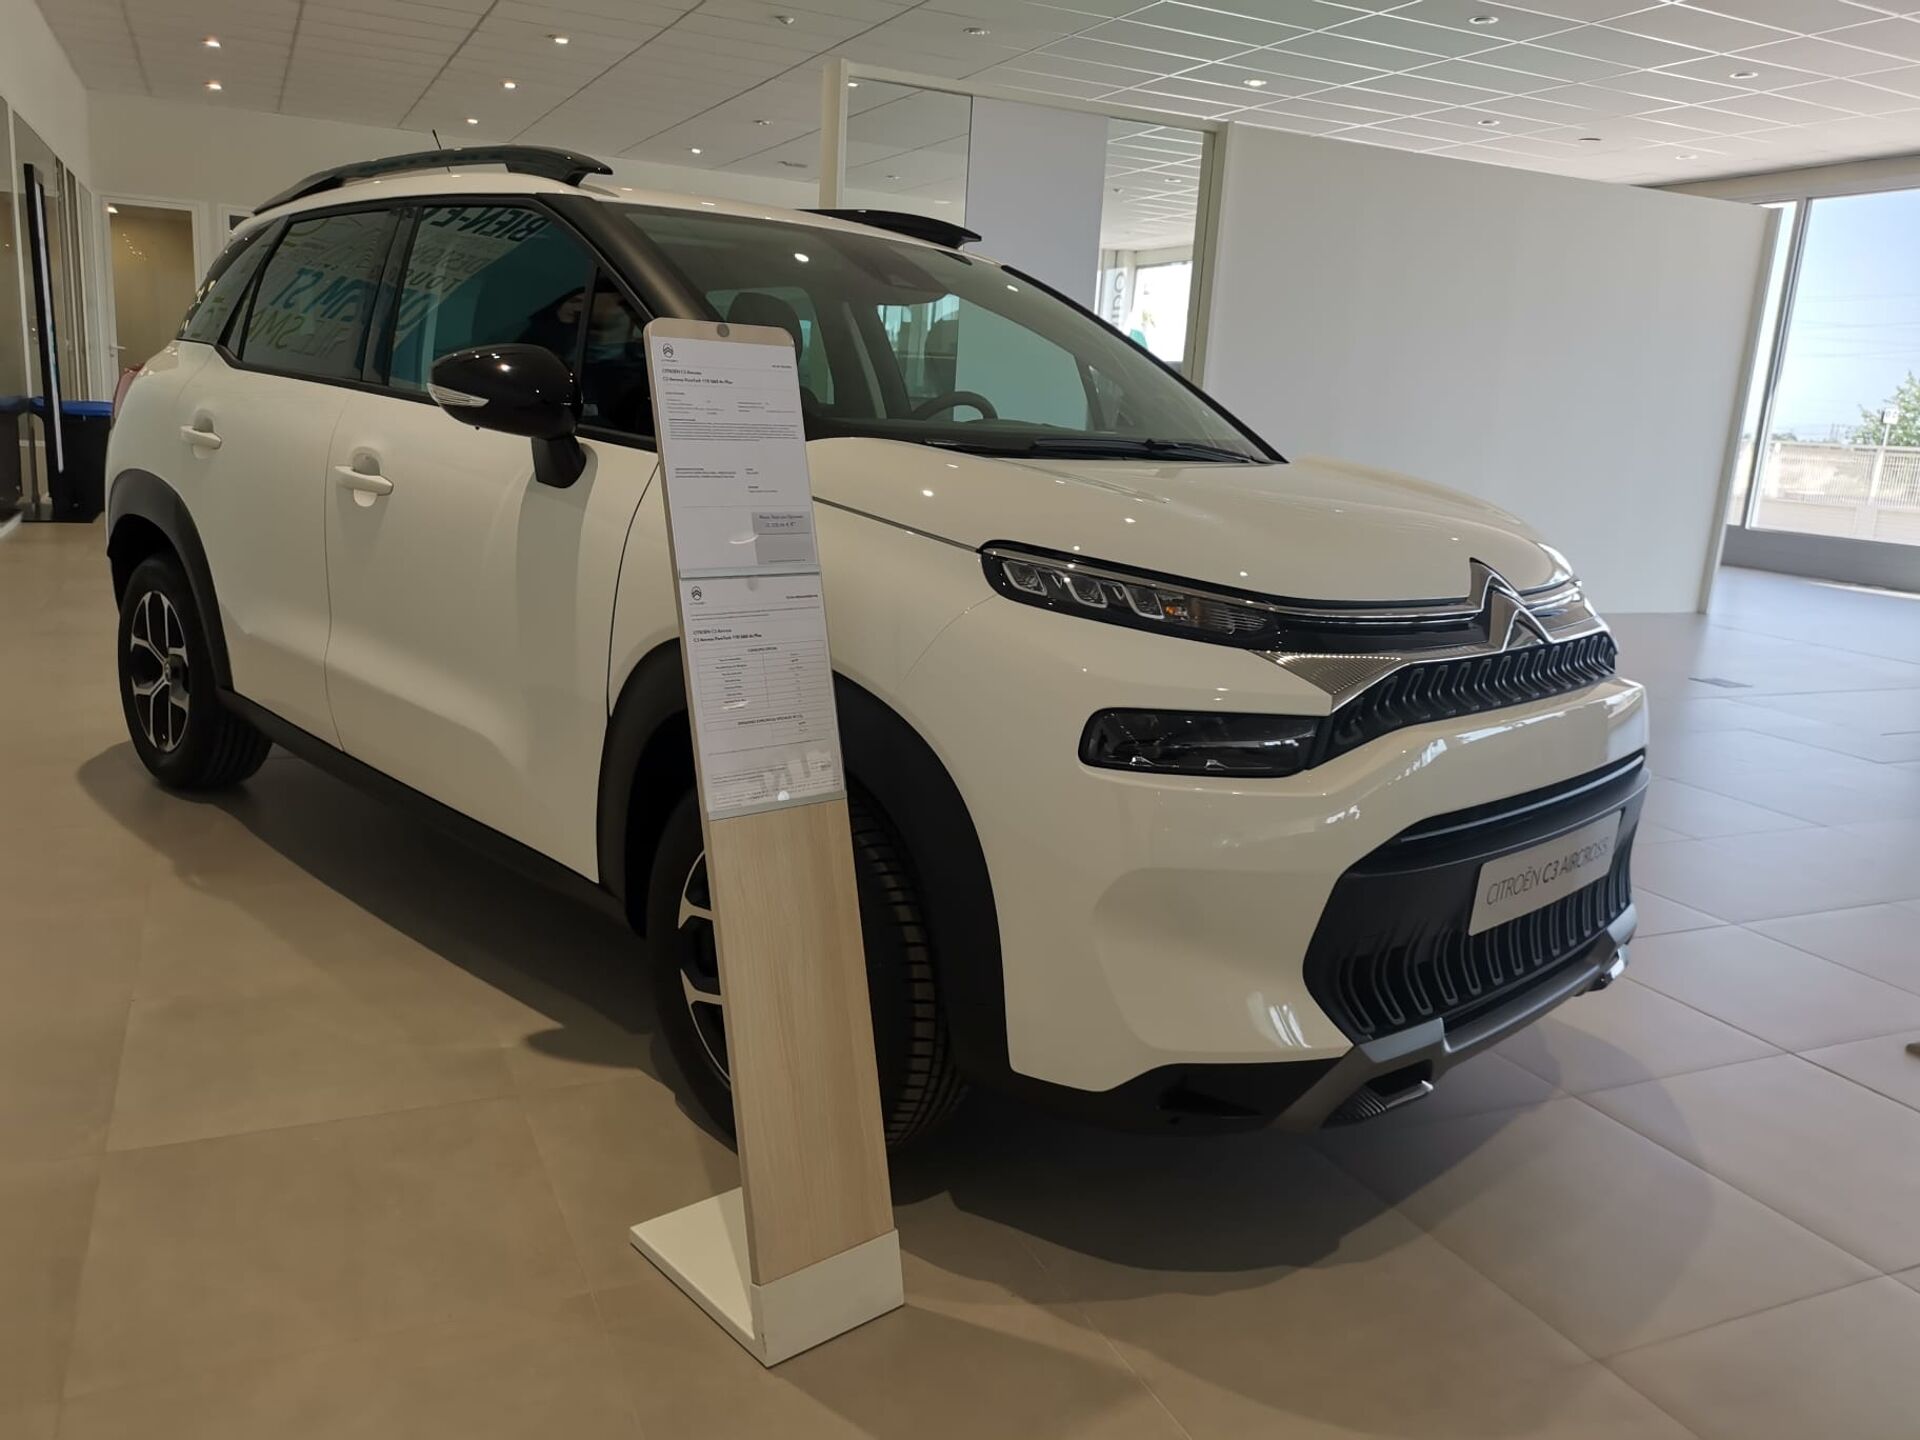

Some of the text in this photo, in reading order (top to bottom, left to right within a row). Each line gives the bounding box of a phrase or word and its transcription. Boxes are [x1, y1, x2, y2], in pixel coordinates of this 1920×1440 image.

[1486, 837, 1609, 906] CITROËN C3 AIRCROSS
